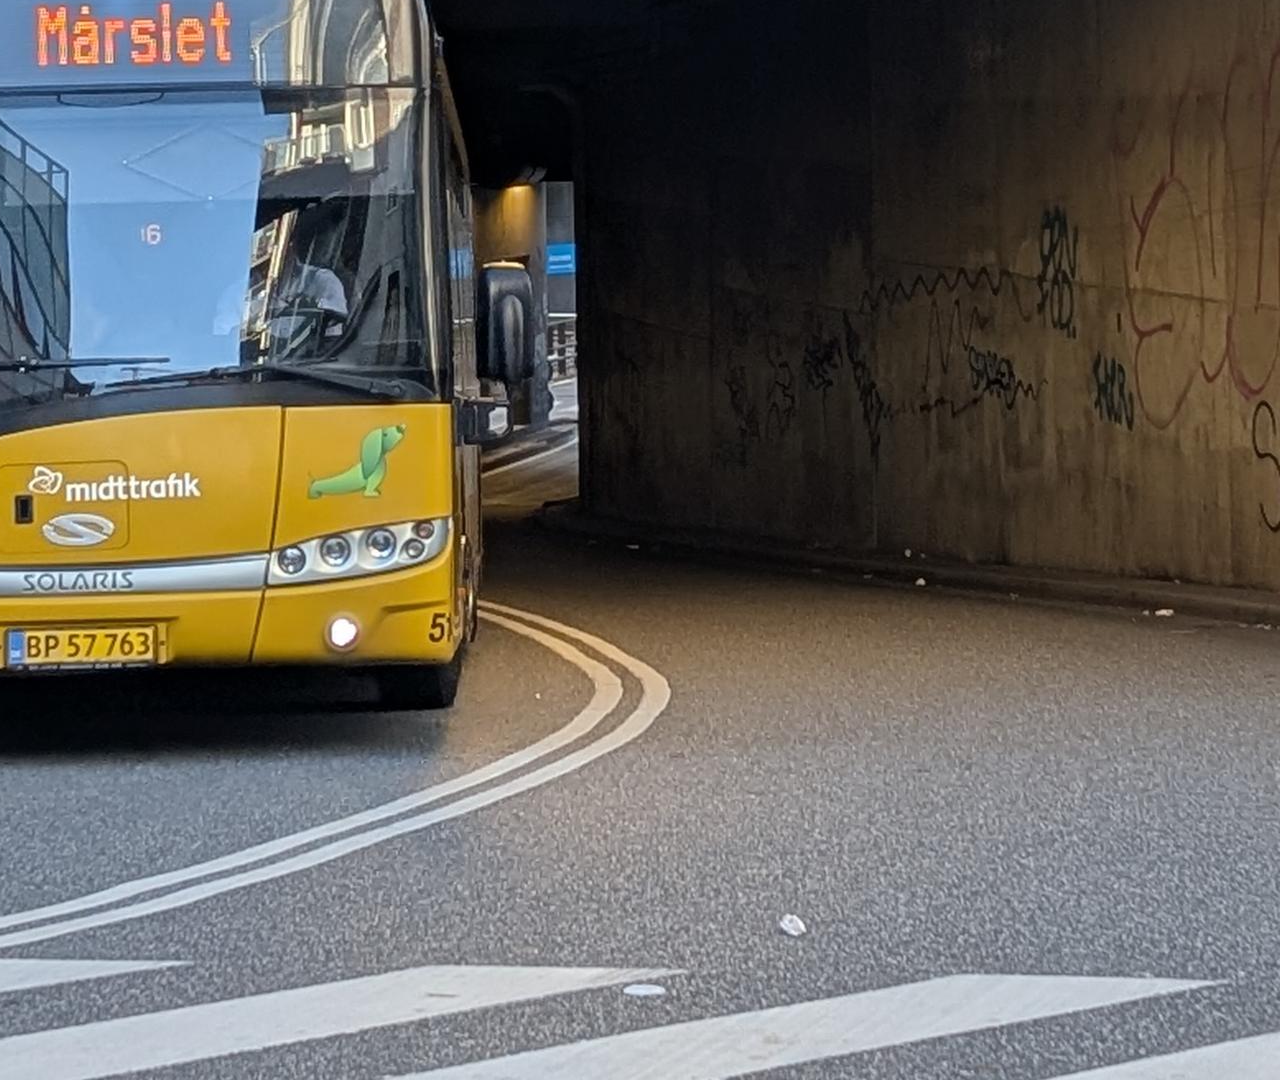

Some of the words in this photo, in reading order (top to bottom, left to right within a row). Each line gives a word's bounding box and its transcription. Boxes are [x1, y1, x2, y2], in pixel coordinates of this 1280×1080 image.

[65, 471, 202, 503] midttrafik
[22, 571, 135, 592] SOLARIS
[26, 634, 60, 658] BP
[66, 633, 98, 658] 57
[103, 631, 151, 657] 763
